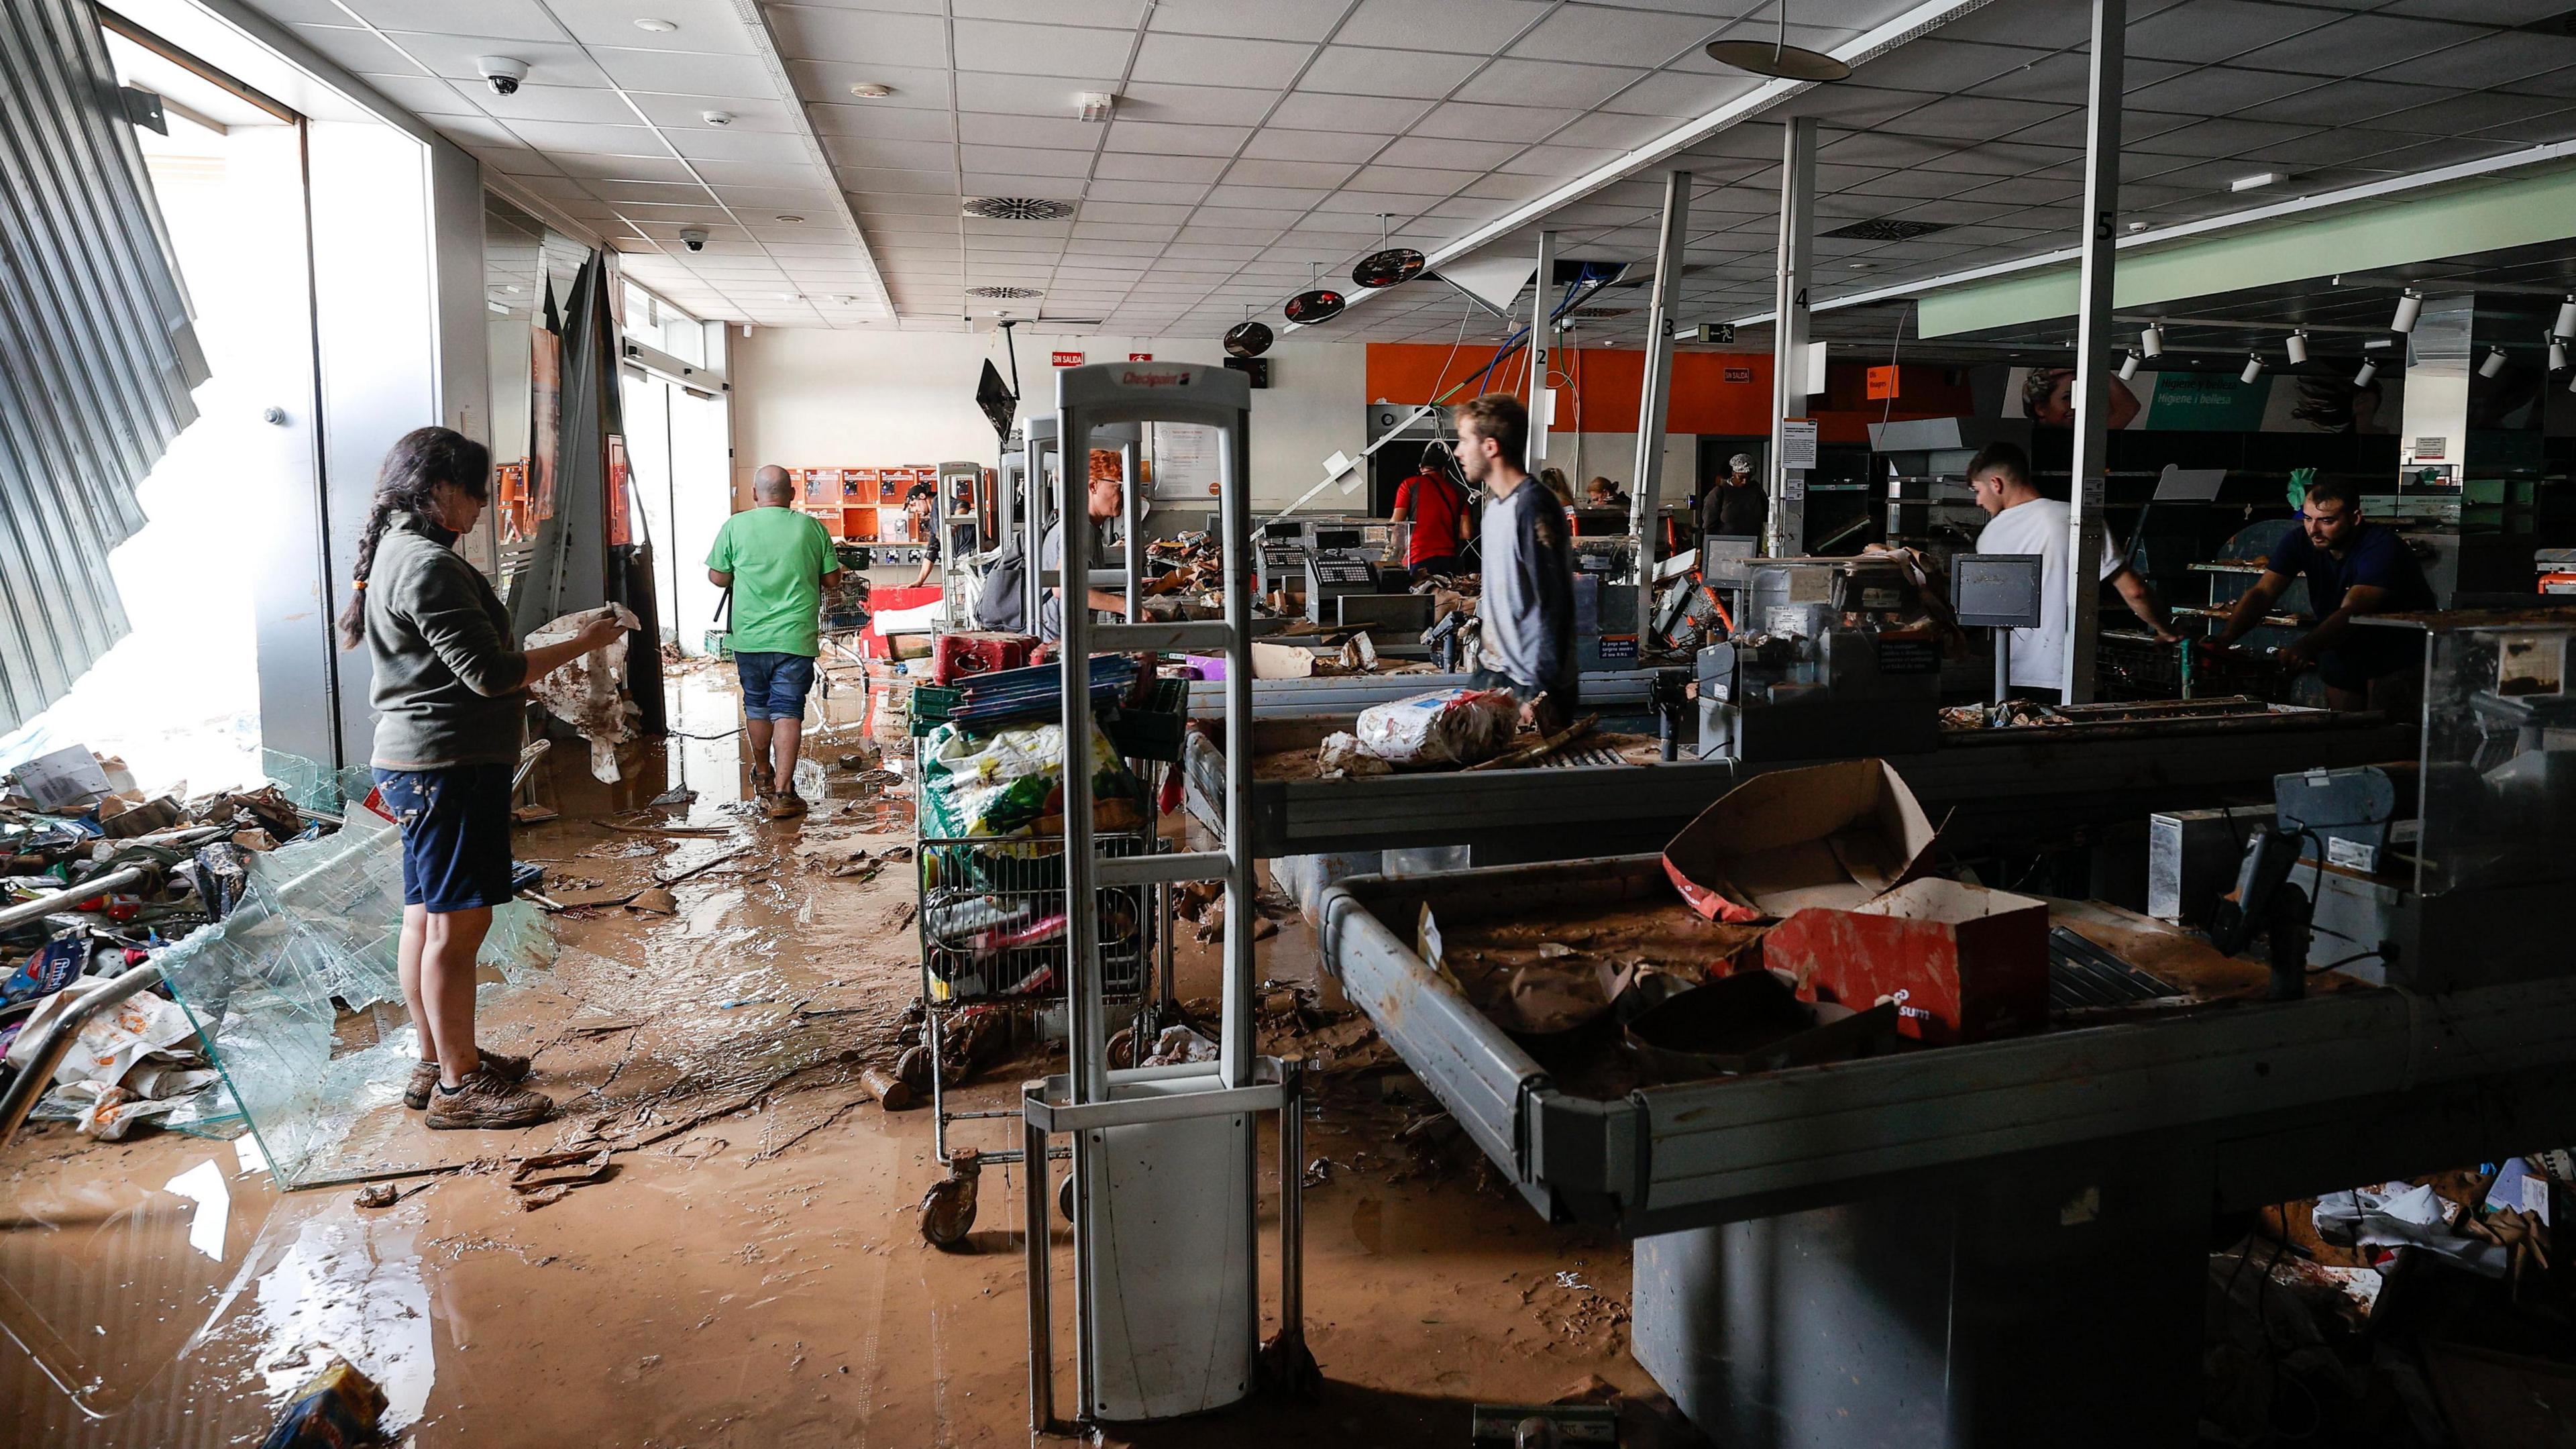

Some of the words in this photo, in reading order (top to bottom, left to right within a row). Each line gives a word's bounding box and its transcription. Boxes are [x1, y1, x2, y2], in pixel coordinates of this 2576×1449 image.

[2096, 211, 2113, 241] 5
[1794, 288, 1809, 309] 4
[1663, 318, 1674, 337] 3
[1063, 356, 1081, 364] SALIDA
[1537, 349, 1546, 365] 2
[2161, 378, 2195, 390] Higiene
[2206, 379, 2237, 390] belleza
[2157, 392, 2193, 406] Higiene
[2200, 393, 2232, 405] bellesa
